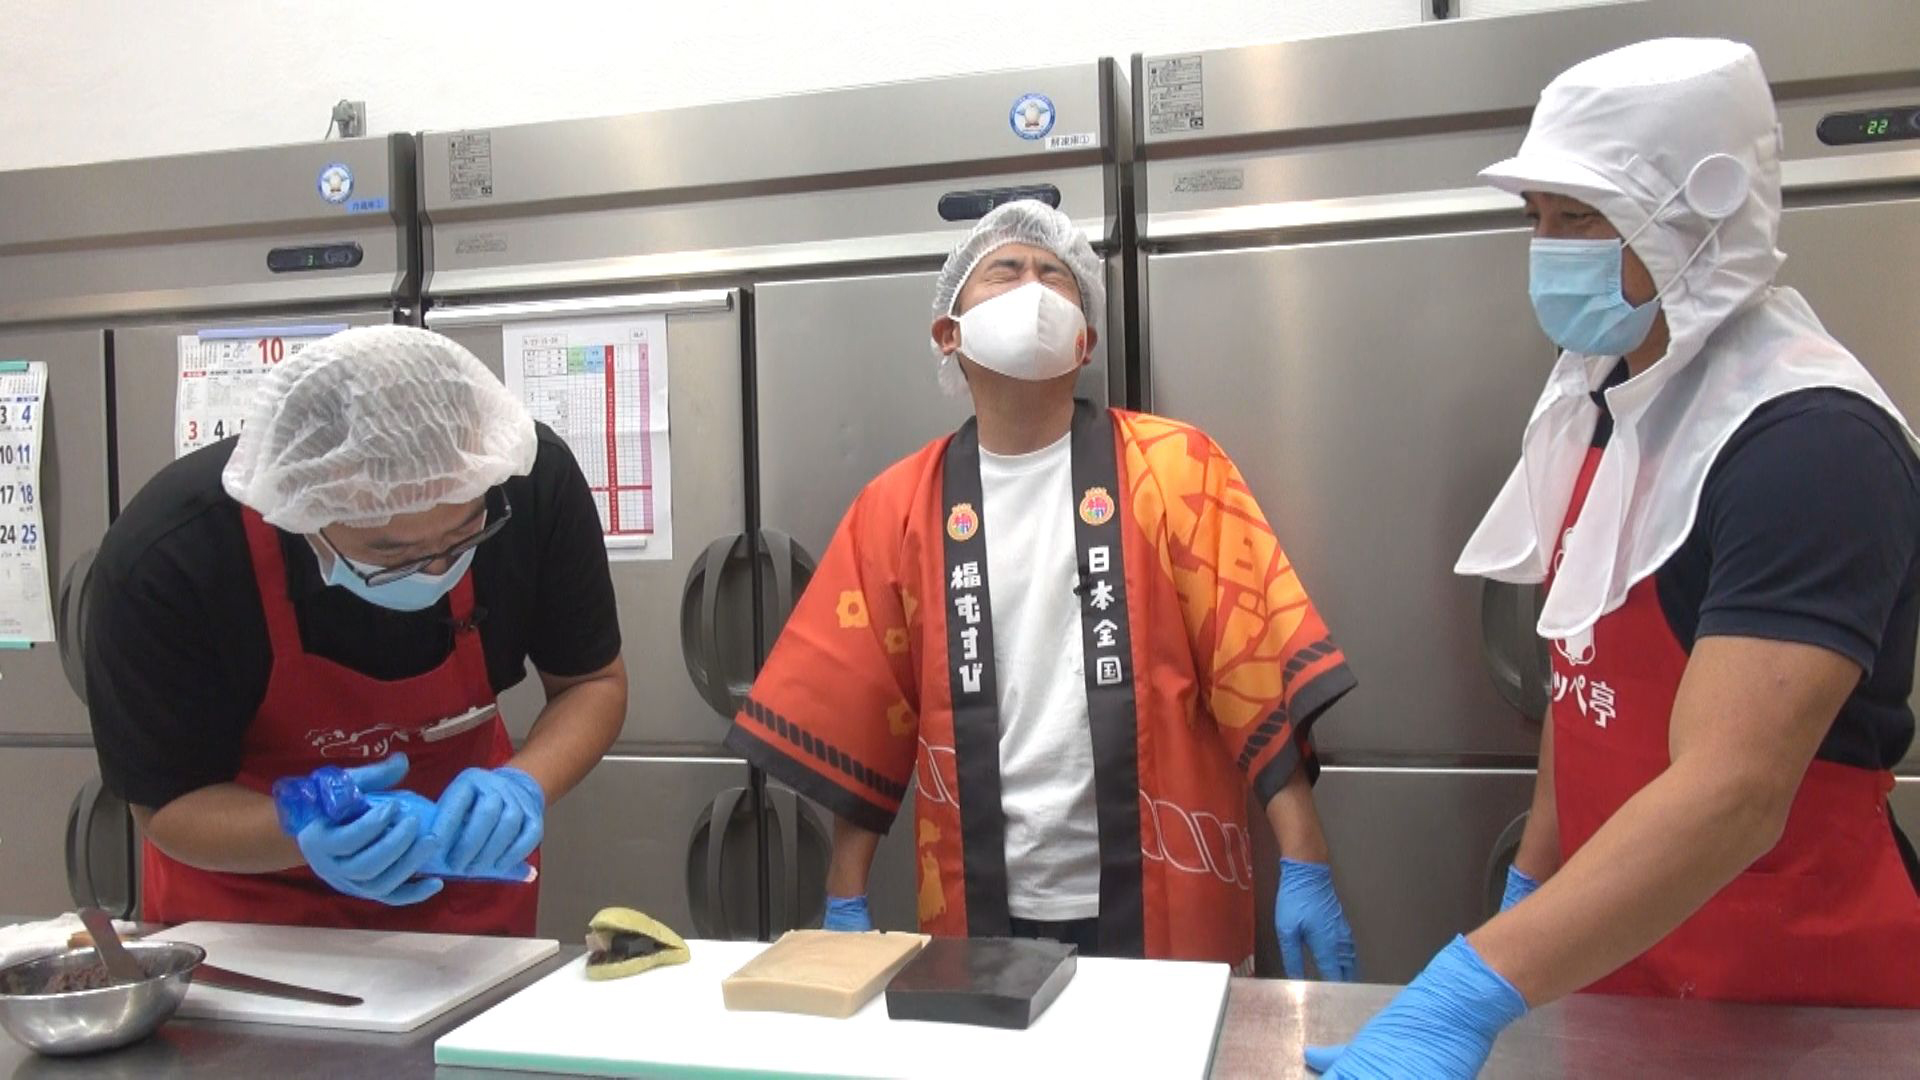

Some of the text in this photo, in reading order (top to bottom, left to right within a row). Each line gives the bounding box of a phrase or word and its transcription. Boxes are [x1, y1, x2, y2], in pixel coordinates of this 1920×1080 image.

[1867, 119, 1888, 134] 22
[258, 336, 284, 365] 10
[21, 405, 31, 424] 4
[188, 419, 225, 440] 3 4
[0, 444, 30, 465] 10 11
[0, 484, 34, 505] 17 18
[0, 524, 37, 545] 24 25
[1088, 546, 1123, 685] 日本全国
[950, 561, 983, 694] 福むすび
